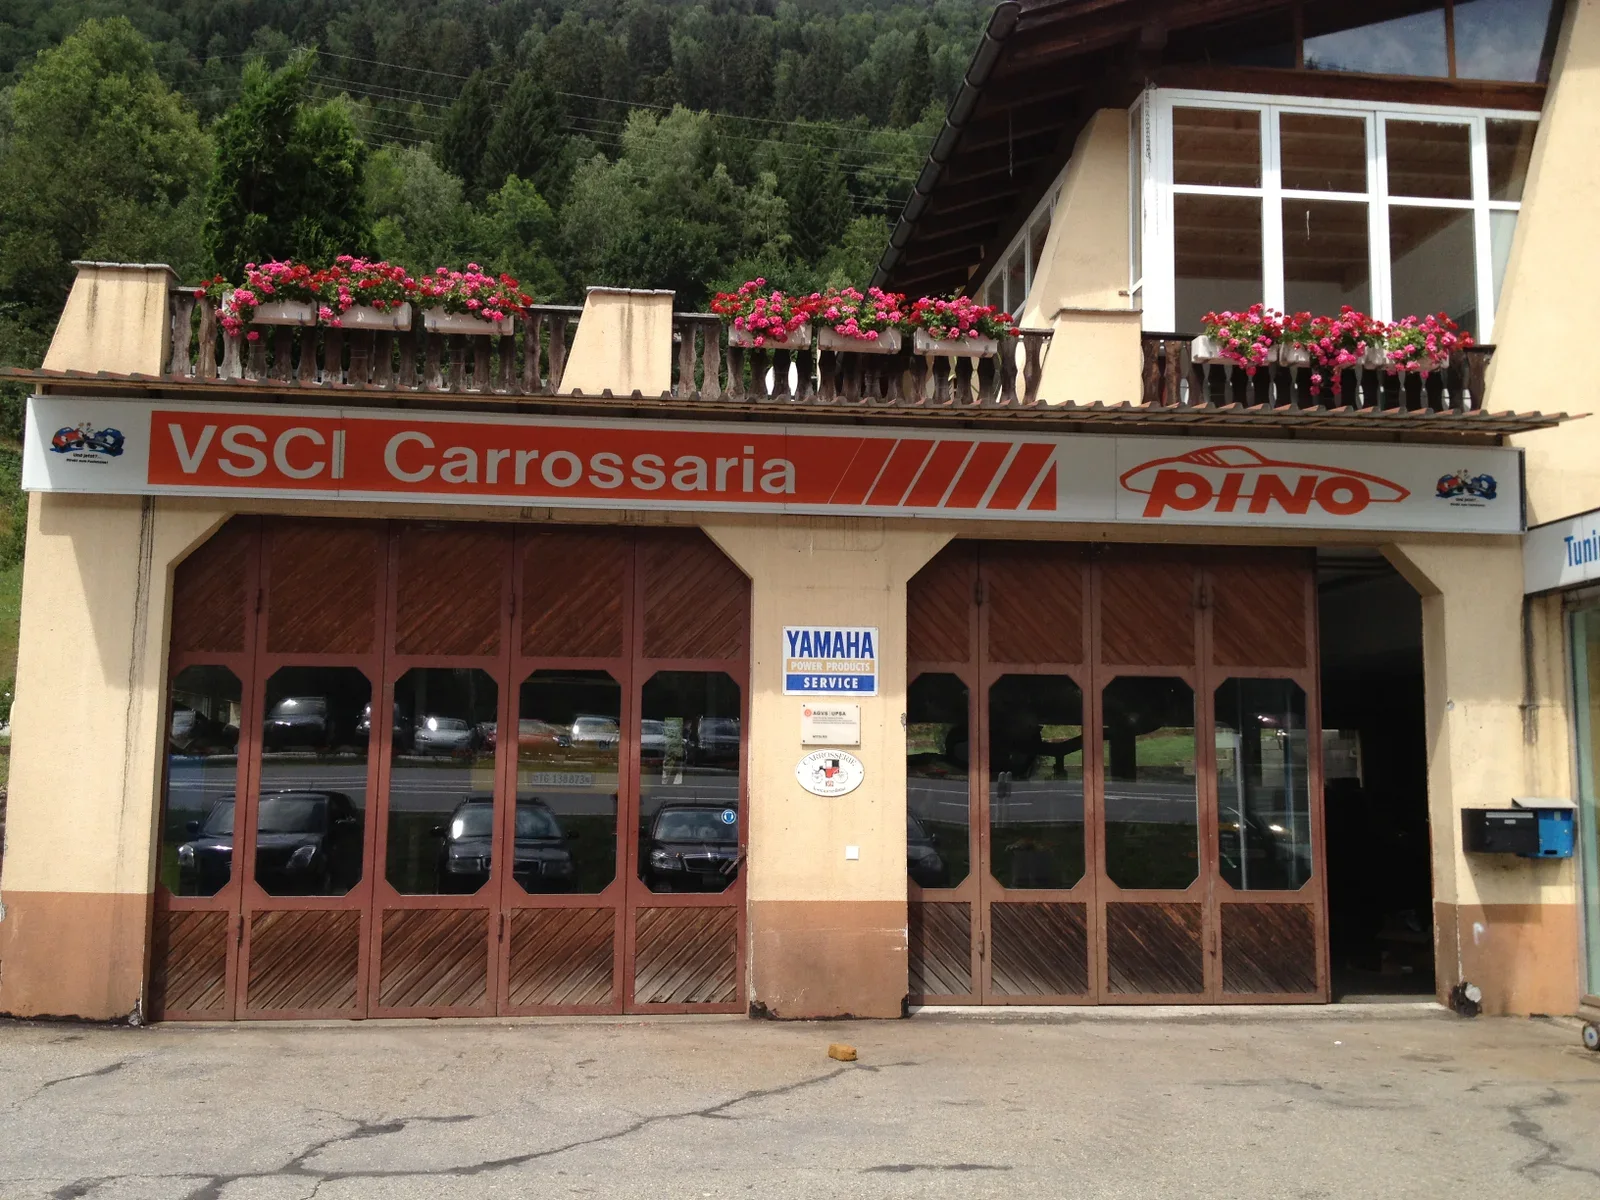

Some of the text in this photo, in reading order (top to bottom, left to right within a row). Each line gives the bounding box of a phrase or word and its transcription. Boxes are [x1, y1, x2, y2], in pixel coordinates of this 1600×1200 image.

[168, 423, 796, 494] VSCI Carrossaria
[1564, 529, 1600, 567] Tuni
[786, 630, 875, 659] YAMAHA
[791, 661, 870, 672] POWER PRODUCTS
[803, 677, 859, 689] SERVICE
[802, 752, 857, 767] CARROSSERIE
